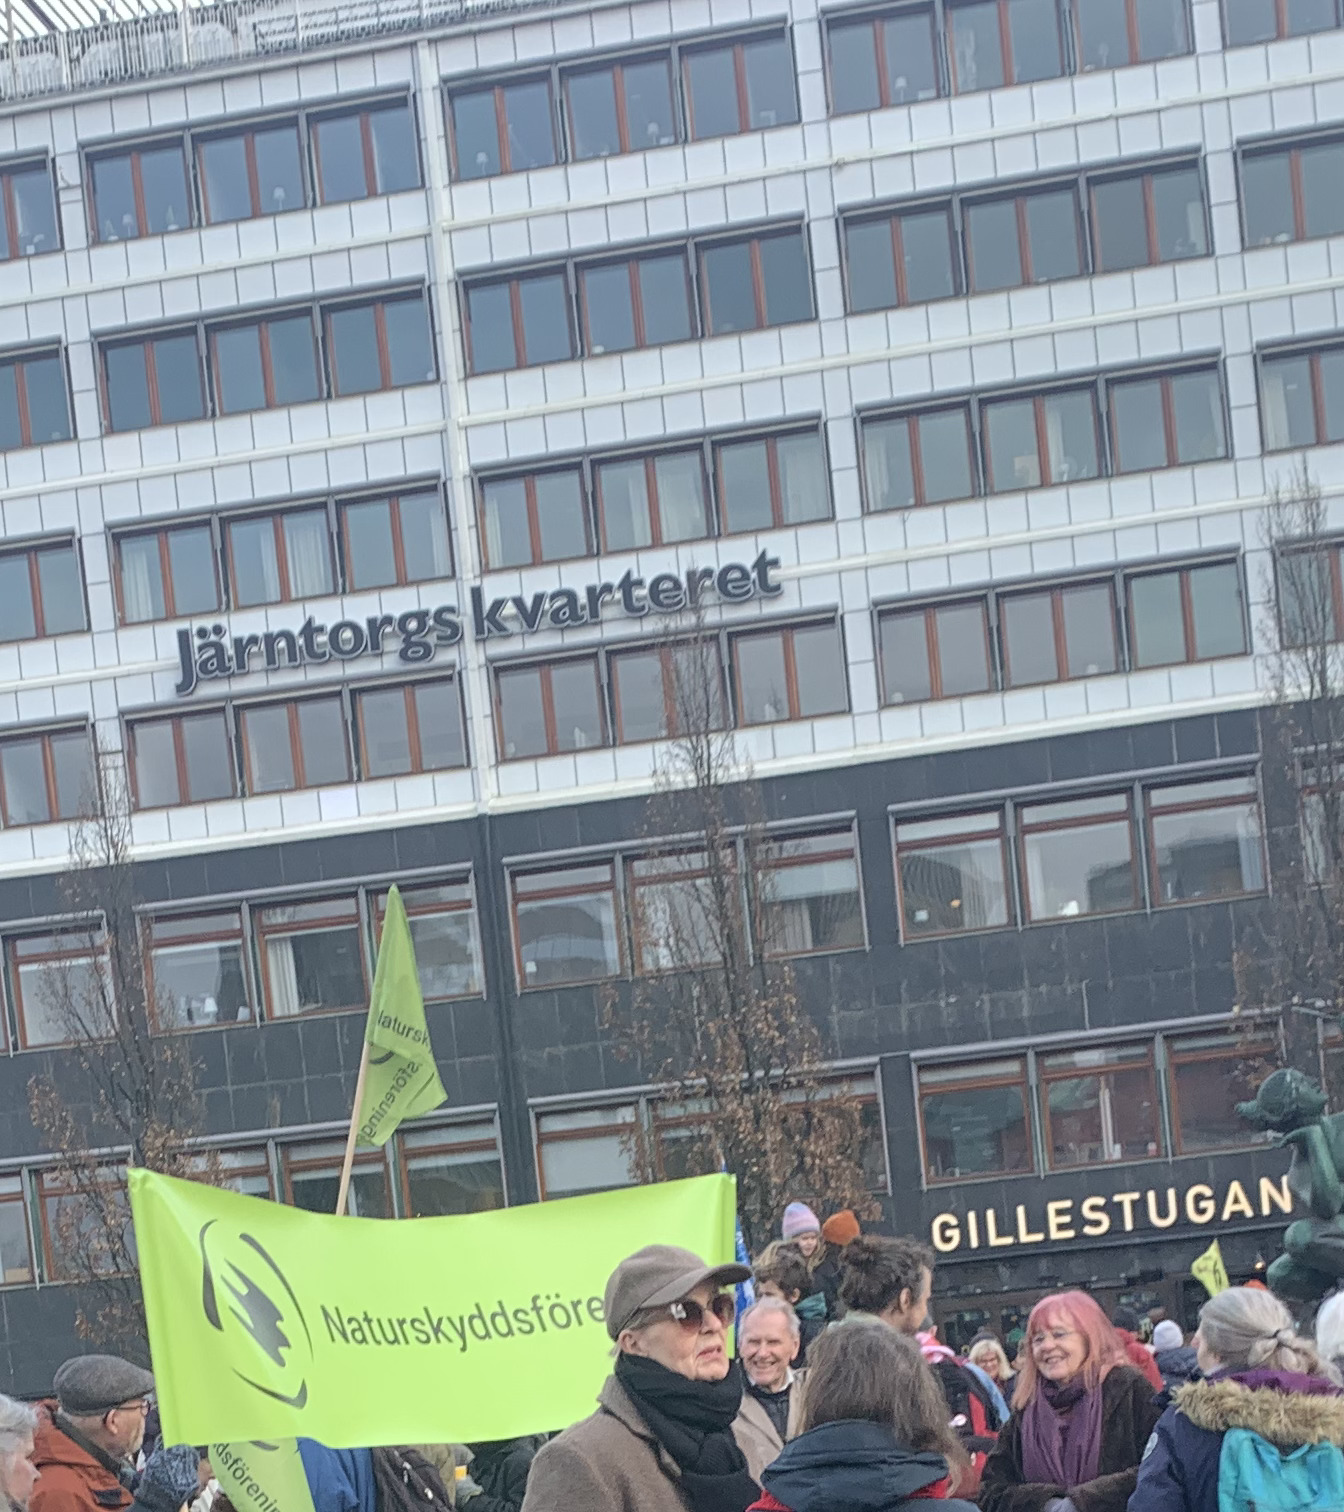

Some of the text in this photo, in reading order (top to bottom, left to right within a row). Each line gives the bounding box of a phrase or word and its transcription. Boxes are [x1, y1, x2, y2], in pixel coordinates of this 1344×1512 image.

[174, 547, 783, 696] Järntorgskvarteret
[930, 1174, 1294, 1253] GILLESTUGAN
[320, 1293, 606, 1352] Naturskyddsföre
